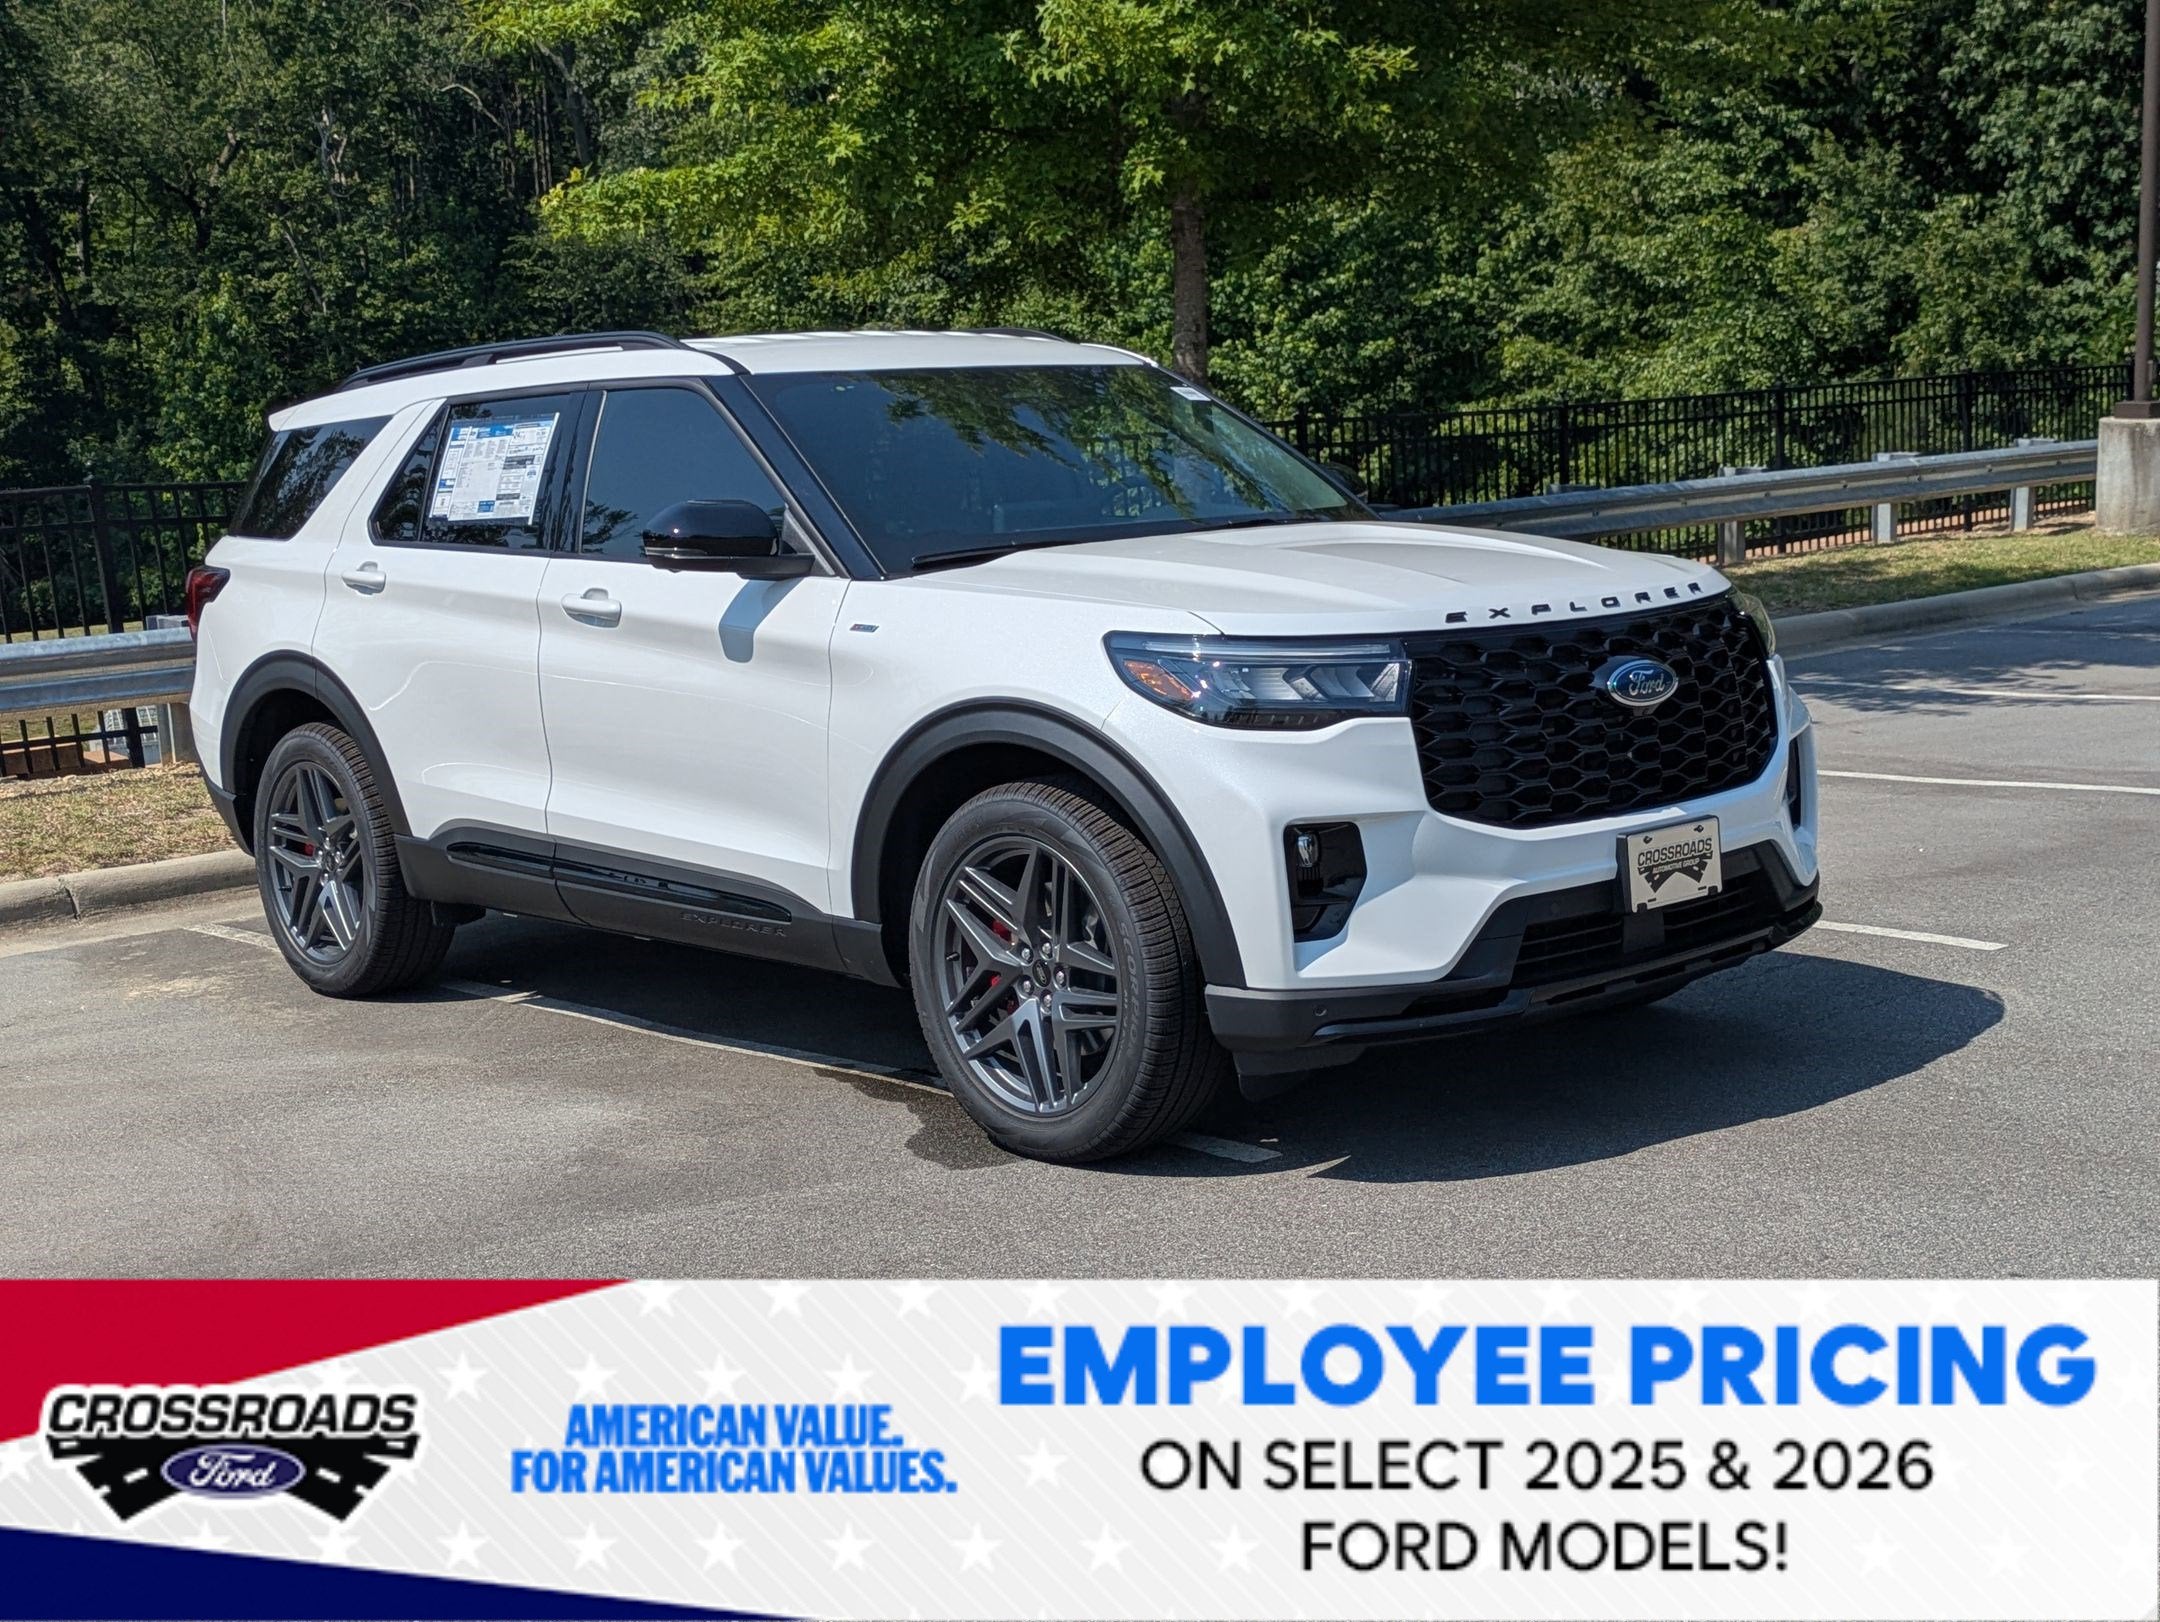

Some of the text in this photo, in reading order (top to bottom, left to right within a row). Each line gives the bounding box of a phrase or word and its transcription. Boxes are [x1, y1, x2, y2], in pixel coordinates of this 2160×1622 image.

[1445, 582, 1703, 624] EXPLORER
[1637, 837, 1713, 867] CROSSROADS
[680, 911, 787, 938] EXPLORER
